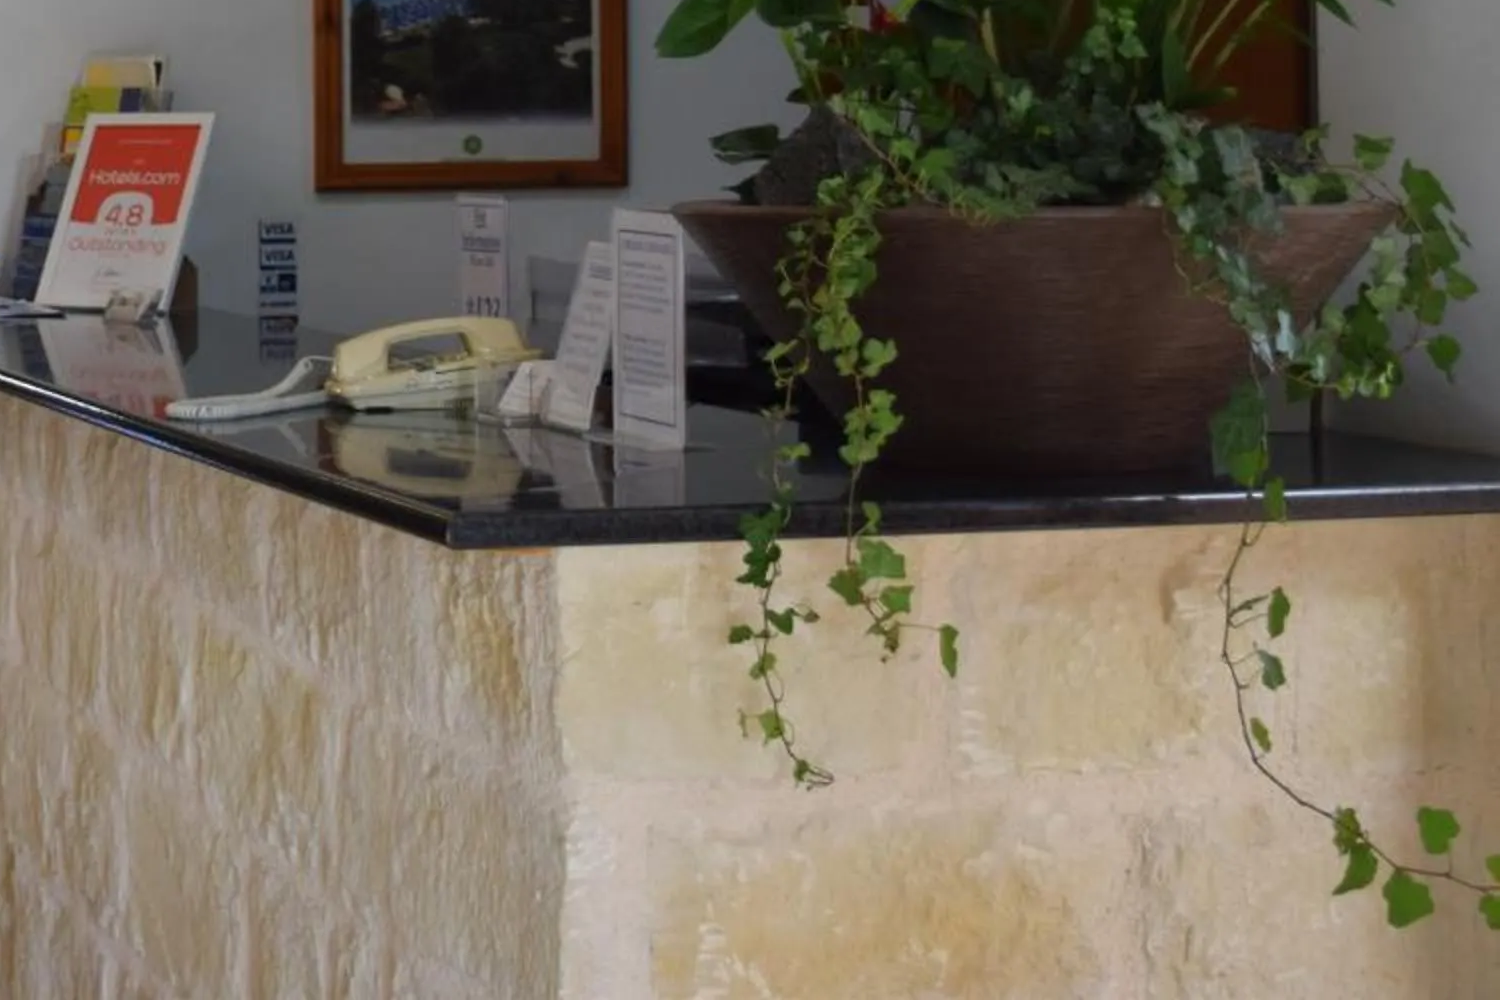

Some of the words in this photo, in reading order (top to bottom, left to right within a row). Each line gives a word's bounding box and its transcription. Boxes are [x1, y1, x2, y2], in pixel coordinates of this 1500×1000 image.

[89, 169, 181, 187] Hotels.com
[104, 203, 146, 227] 4.8
[264, 222, 295, 235] VISA
[67, 236, 167, 256] Outstanding
[264, 249, 296, 262] VISA
